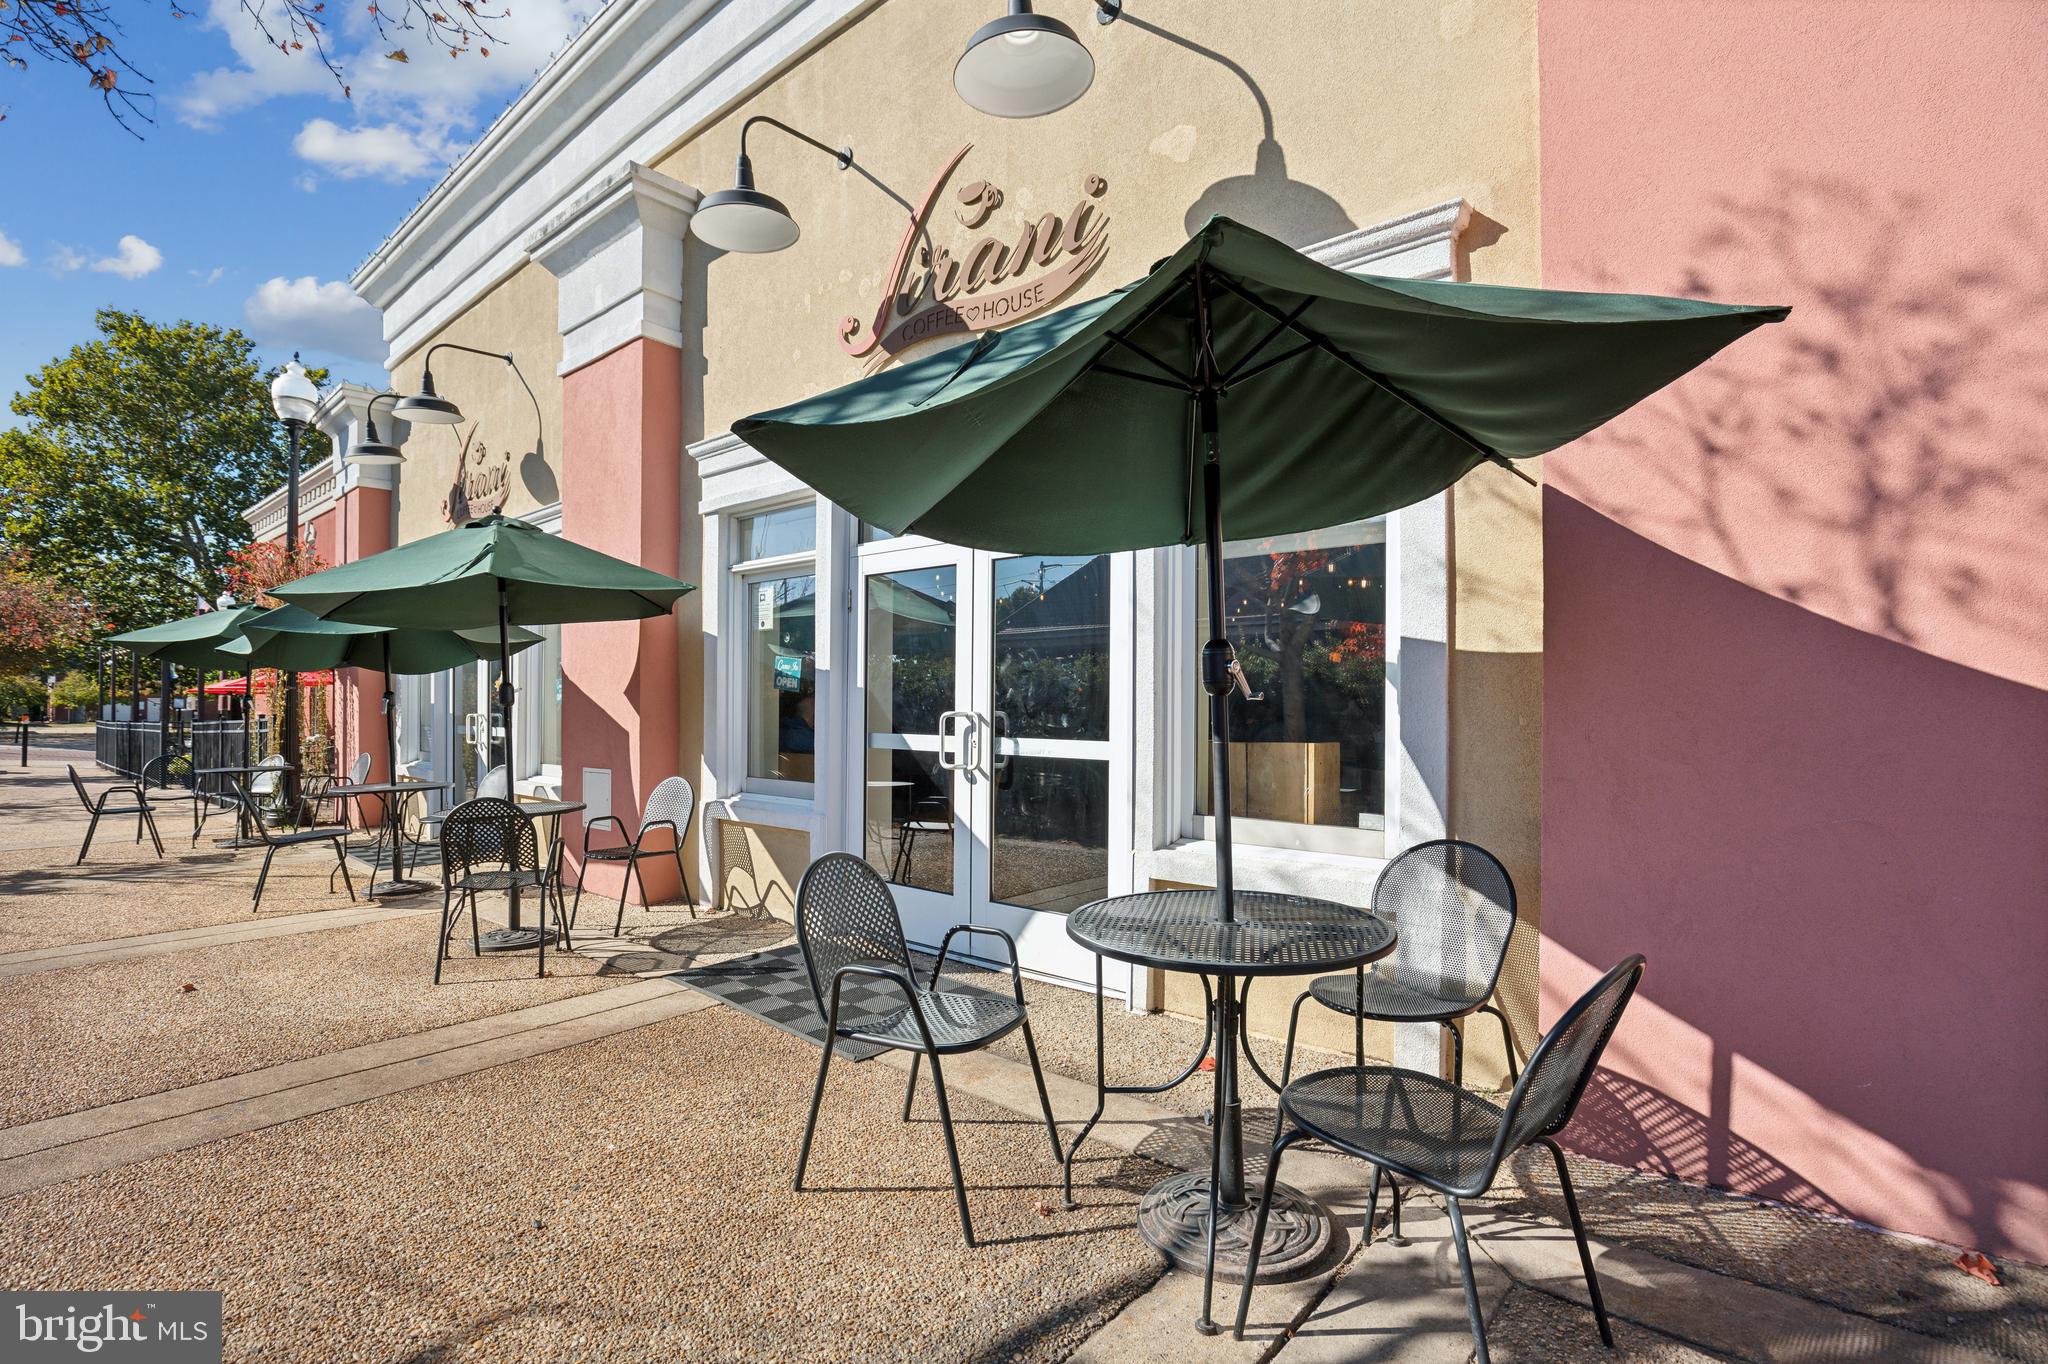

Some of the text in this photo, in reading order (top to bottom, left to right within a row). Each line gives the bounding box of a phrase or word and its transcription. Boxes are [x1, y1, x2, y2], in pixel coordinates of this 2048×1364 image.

[902, 282, 1046, 342] COFFEE HOUSE
[776, 676, 798, 688] OPEN
